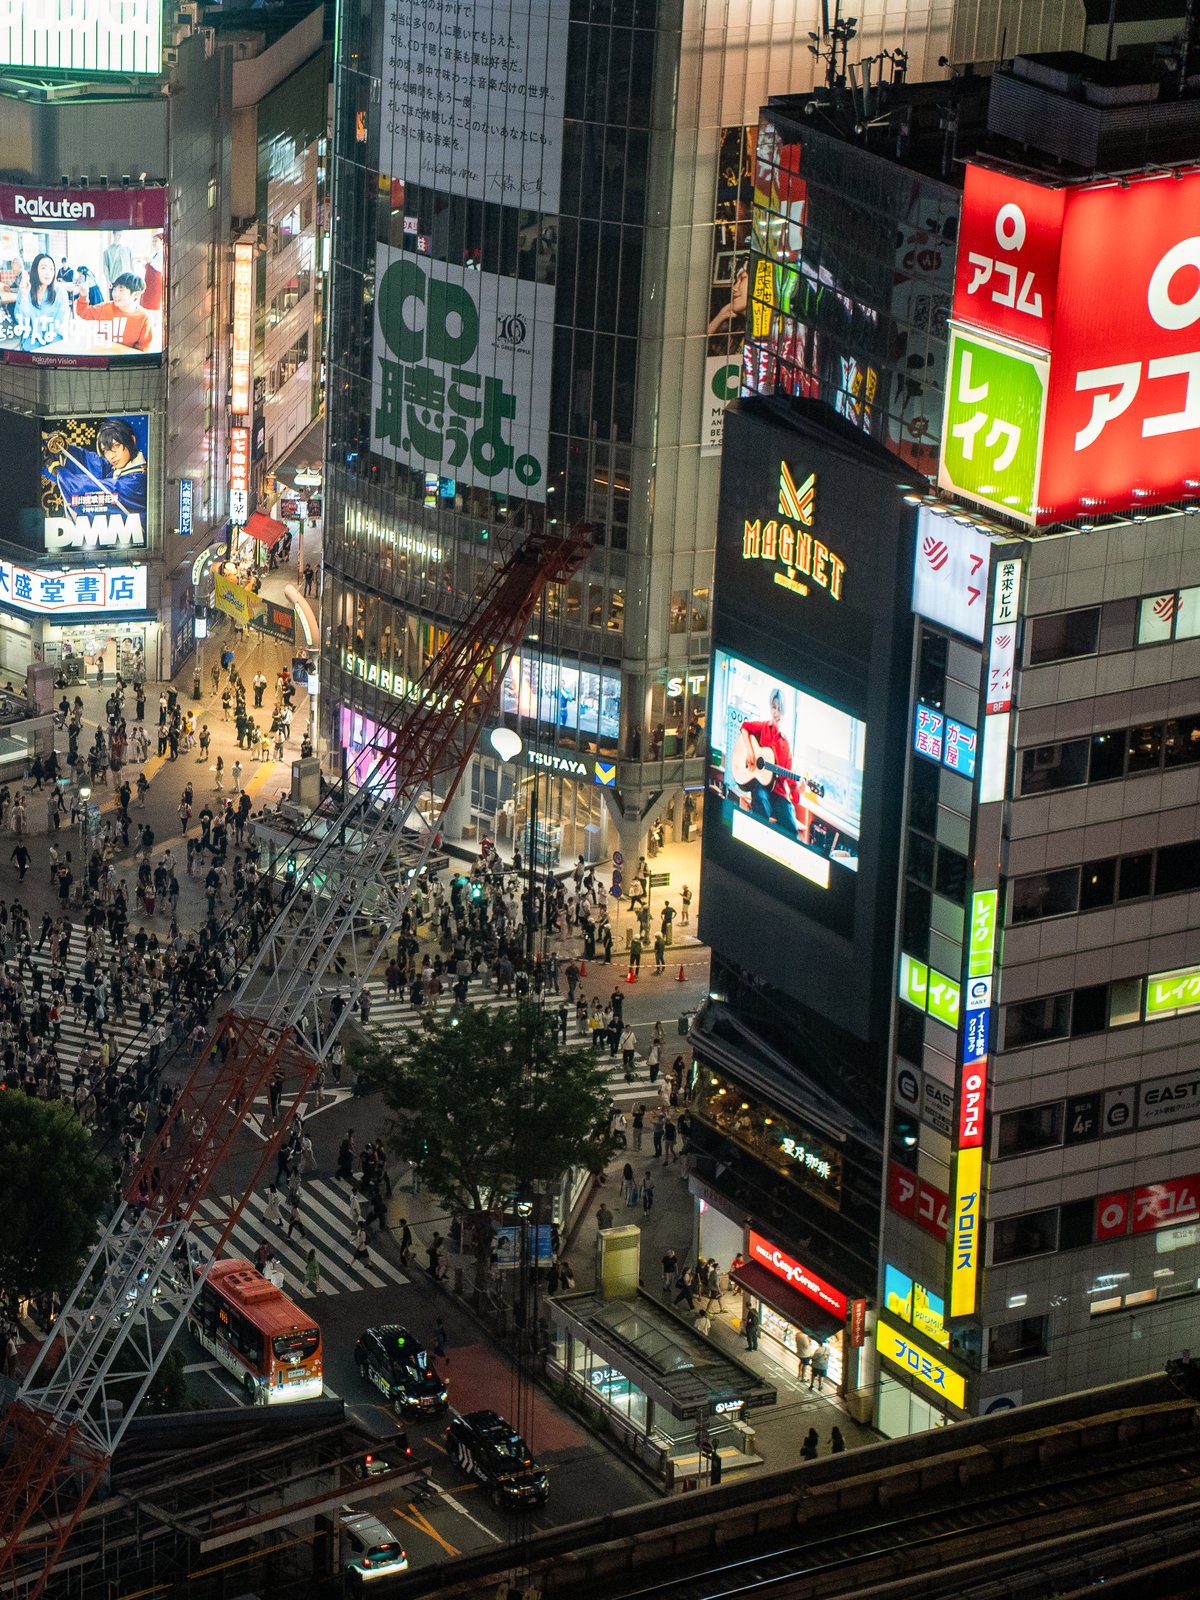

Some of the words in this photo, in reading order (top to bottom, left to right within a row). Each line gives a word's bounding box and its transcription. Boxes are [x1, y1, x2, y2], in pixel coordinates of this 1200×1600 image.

[14, 194, 95, 219] Rakuten
[966, 251, 1044, 319] アコム
[377, 259, 480, 366] CD
[58, 357, 77, 365] Vision
[45, 513, 145, 548] DMM
[743, 518, 846, 600] MAGNET
[528, 750, 588, 776] TSUTAYA
[916, 730, 959, 768] 居酒屋
[975, 899, 990, 943] レイク
[911, 966, 960, 1013] レイク
[963, 1091, 981, 1138] アコム
[1072, 1114, 1093, 1134] 4F
[1136, 1188, 1197, 1222] アコム
[956, 1191, 978, 1271] プロミス
[894, 1337, 946, 1390] プロミス
